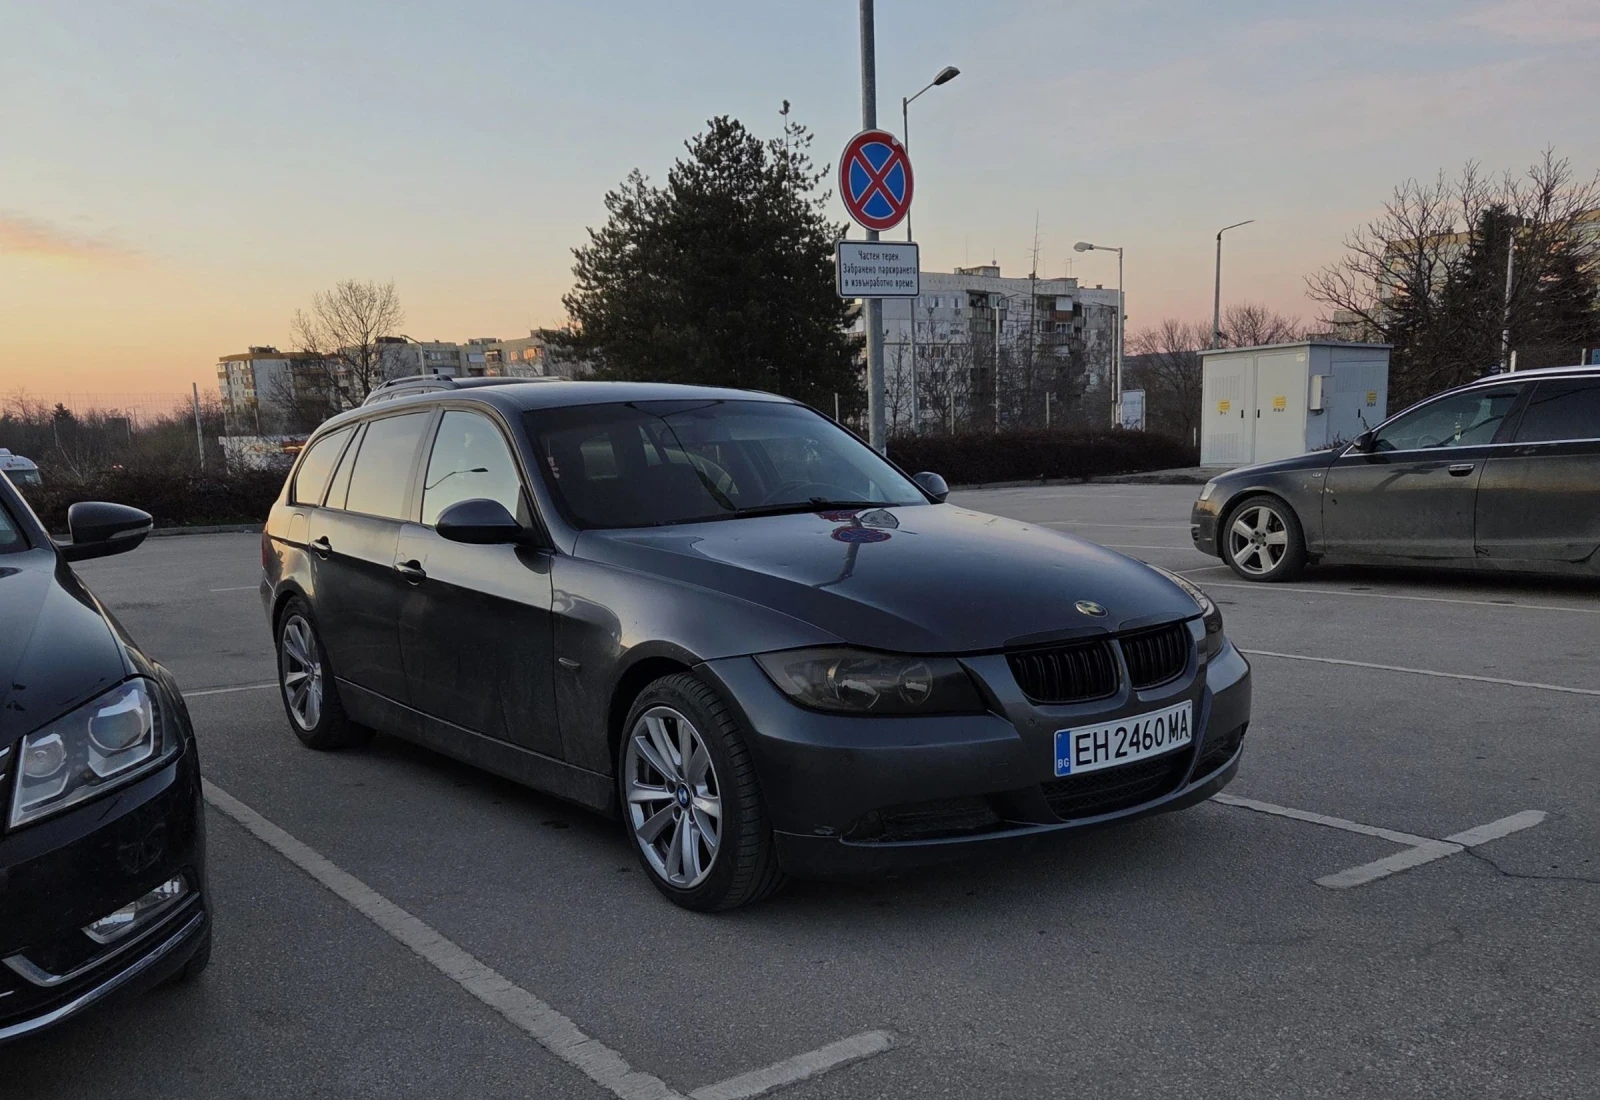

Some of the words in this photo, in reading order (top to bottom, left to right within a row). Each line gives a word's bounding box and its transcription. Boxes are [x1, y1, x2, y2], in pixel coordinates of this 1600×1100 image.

[858, 250, 880, 260] Частен
[843, 263, 876, 276] Забранено
[878, 266, 916, 276] паркирането
[1057, 758, 1069, 769] BG
